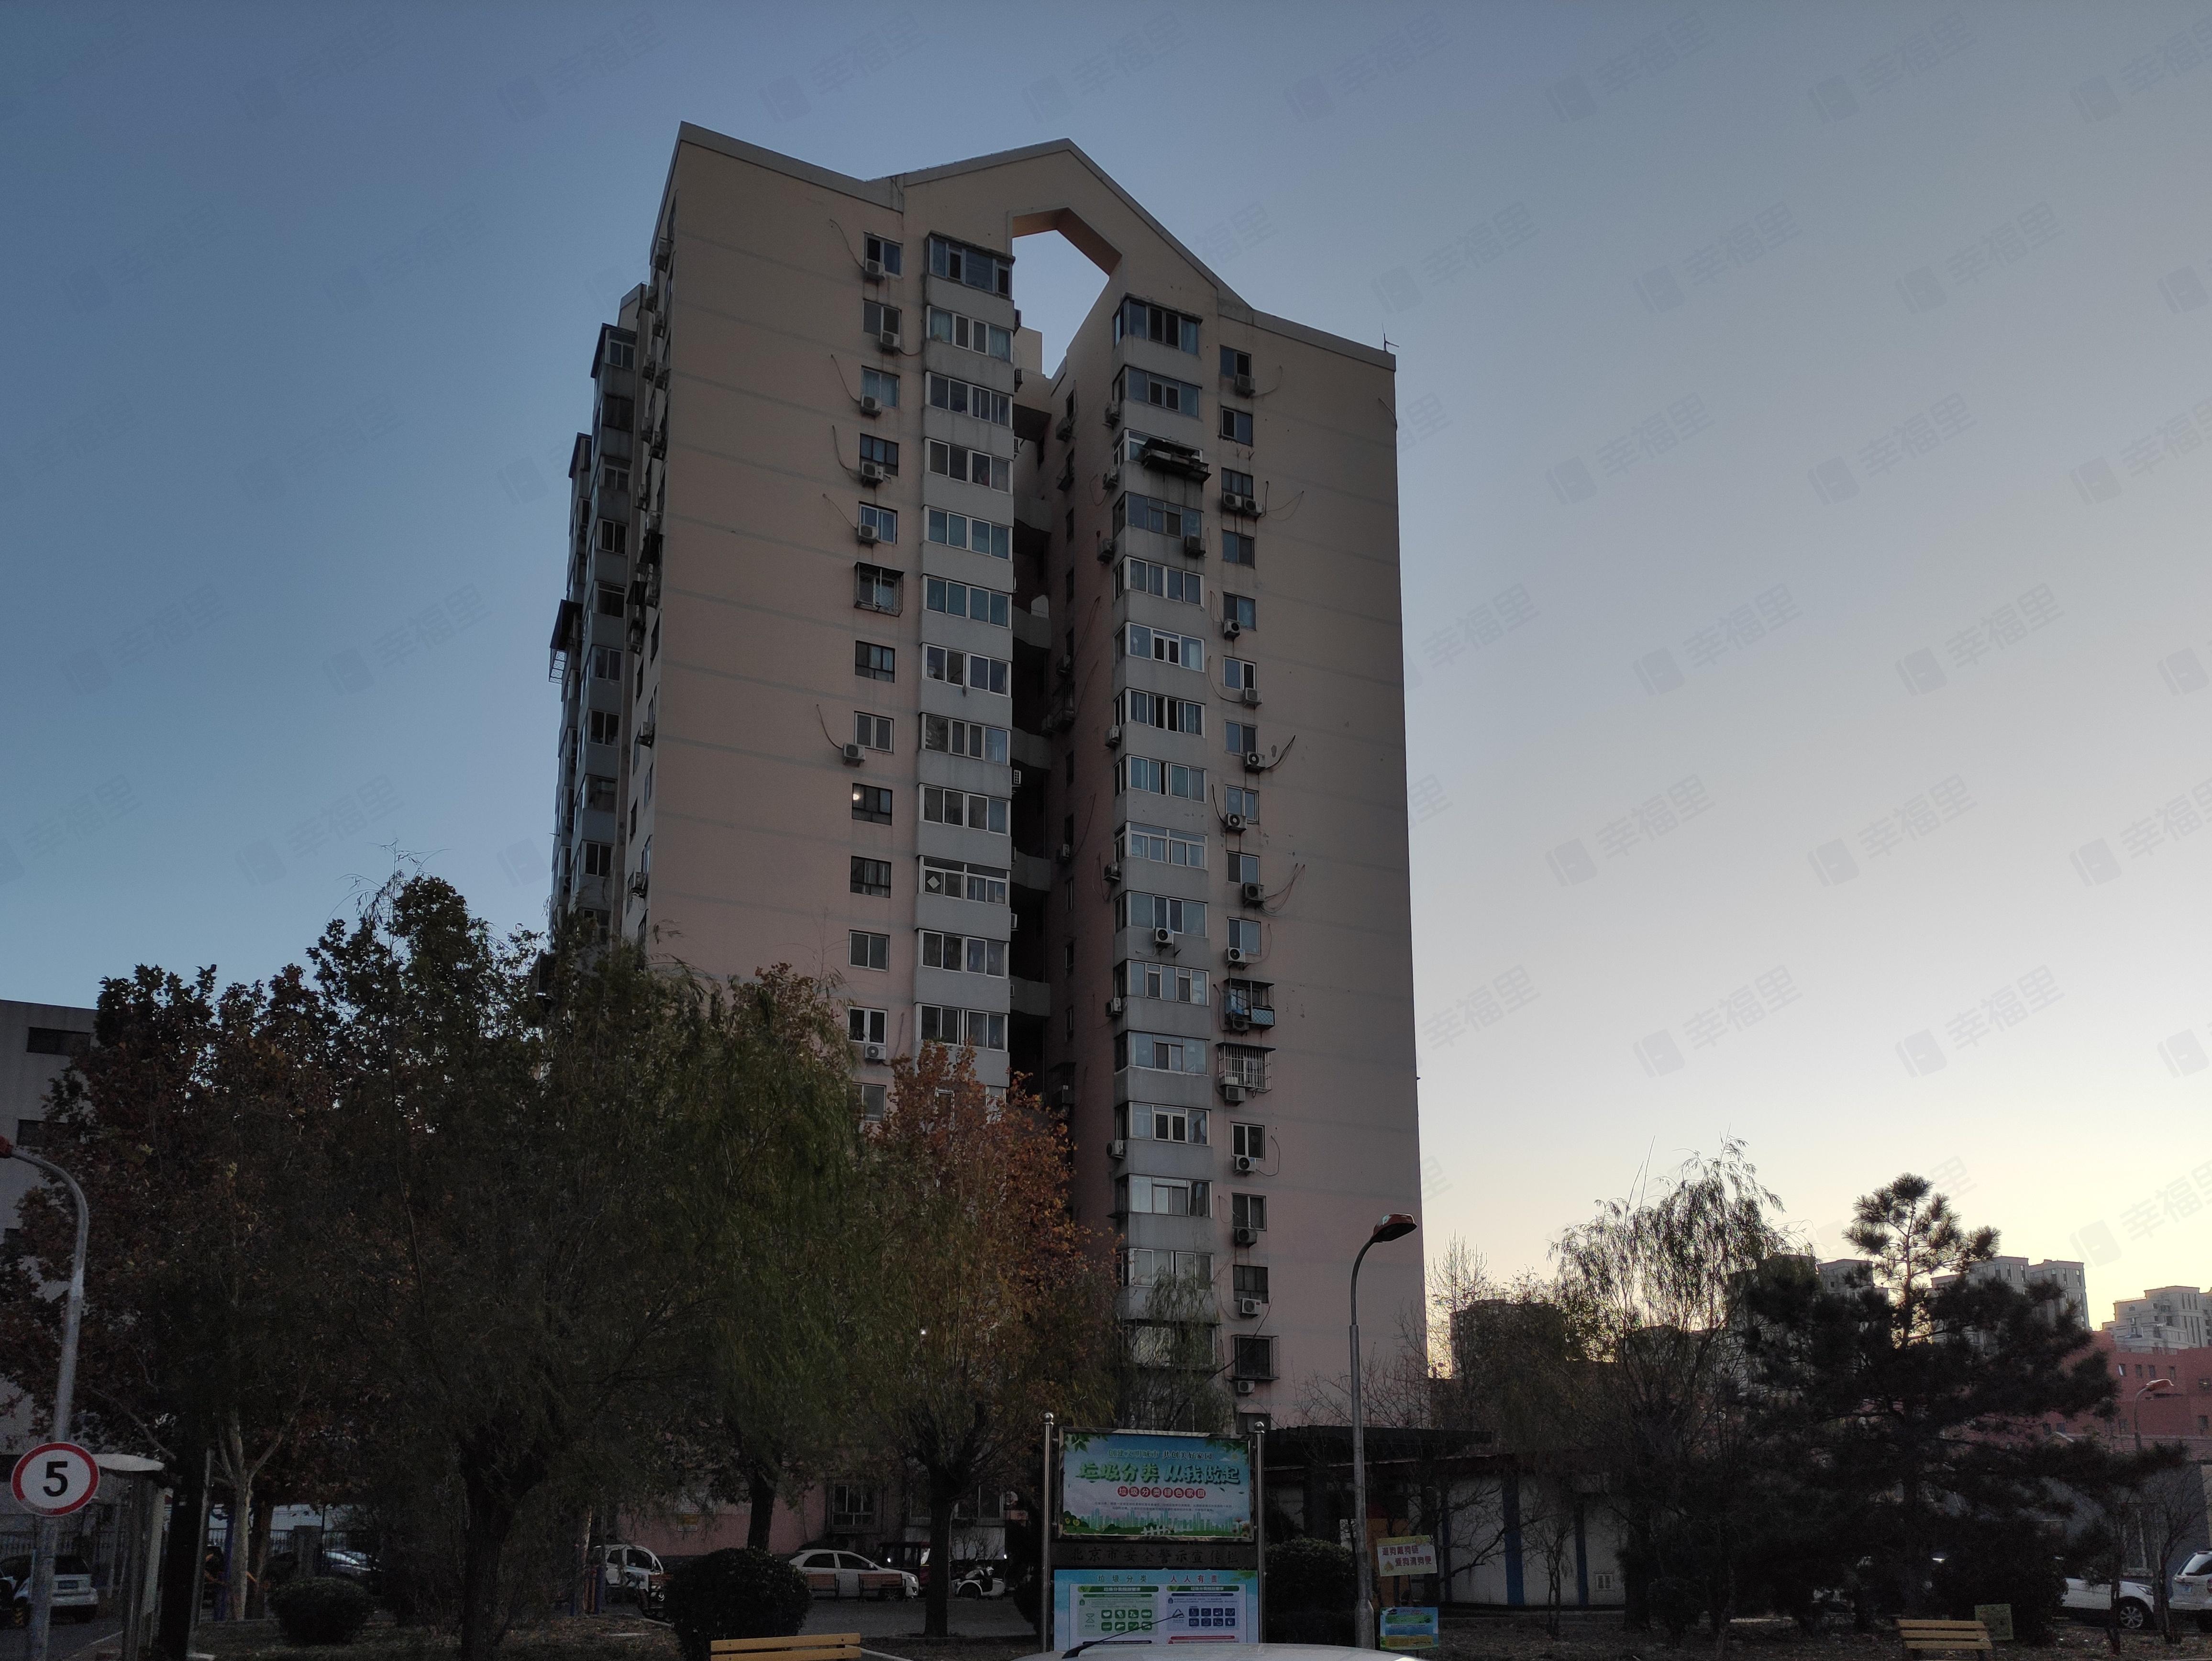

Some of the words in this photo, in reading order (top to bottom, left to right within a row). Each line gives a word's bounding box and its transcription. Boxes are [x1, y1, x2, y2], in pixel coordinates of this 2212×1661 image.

[1108, 1449, 1159, 1459] 创建文明城市
[1163, 1450, 1213, 1460] 共创美好家园
[43, 1461, 68, 1497] 5
[1077, 1462, 1160, 1483] 垃圾分类
[1164, 1464, 1240, 1485] 从我做起
[1118, 1487, 1205, 1498] 垃圾分类绿色家园
[1071, 1547, 1239, 1564] 北京市安全警示宣传栏
[1098, 1574, 1147, 1583] 垃圾分类
[1171, 1575, 1218, 1583] 人人有责
